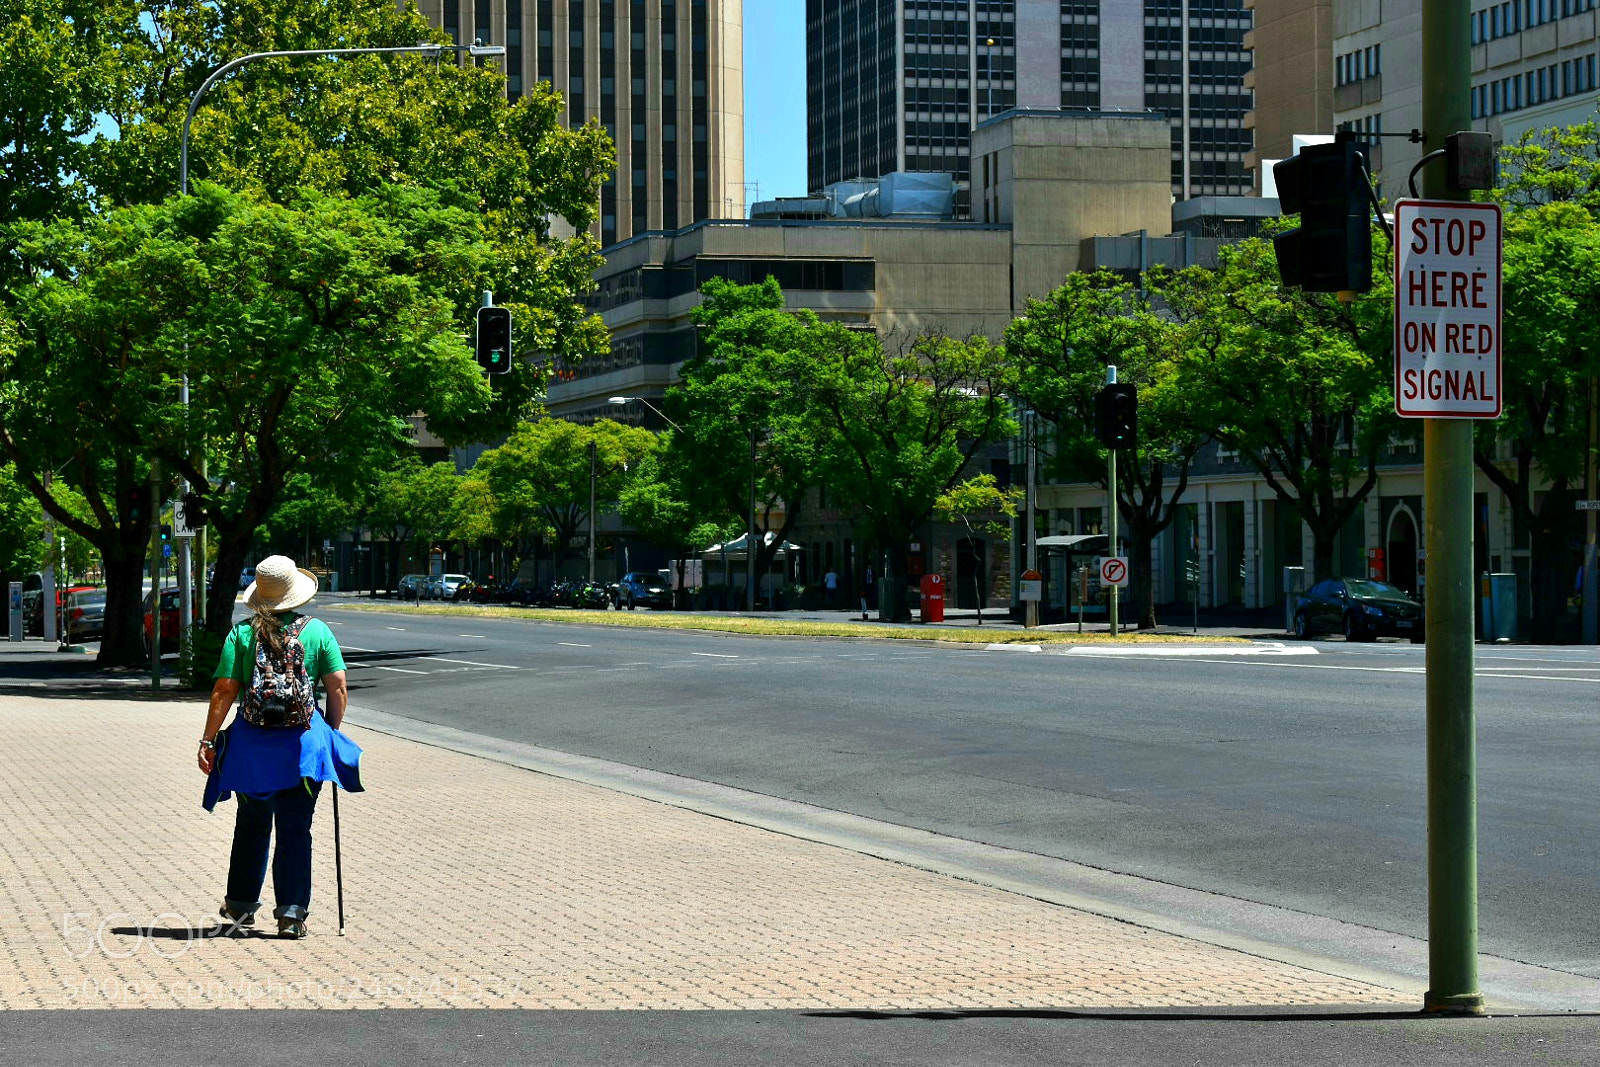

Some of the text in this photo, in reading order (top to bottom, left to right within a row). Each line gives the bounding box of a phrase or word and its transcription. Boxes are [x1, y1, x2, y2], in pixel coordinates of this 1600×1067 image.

[1411, 217, 1486, 256] STOP
[1409, 270, 1487, 308] HERE
[1404, 321, 1493, 354] ON RED
[1403, 368, 1494, 401] SIGNAL
[176, 524, 196, 533] LA
